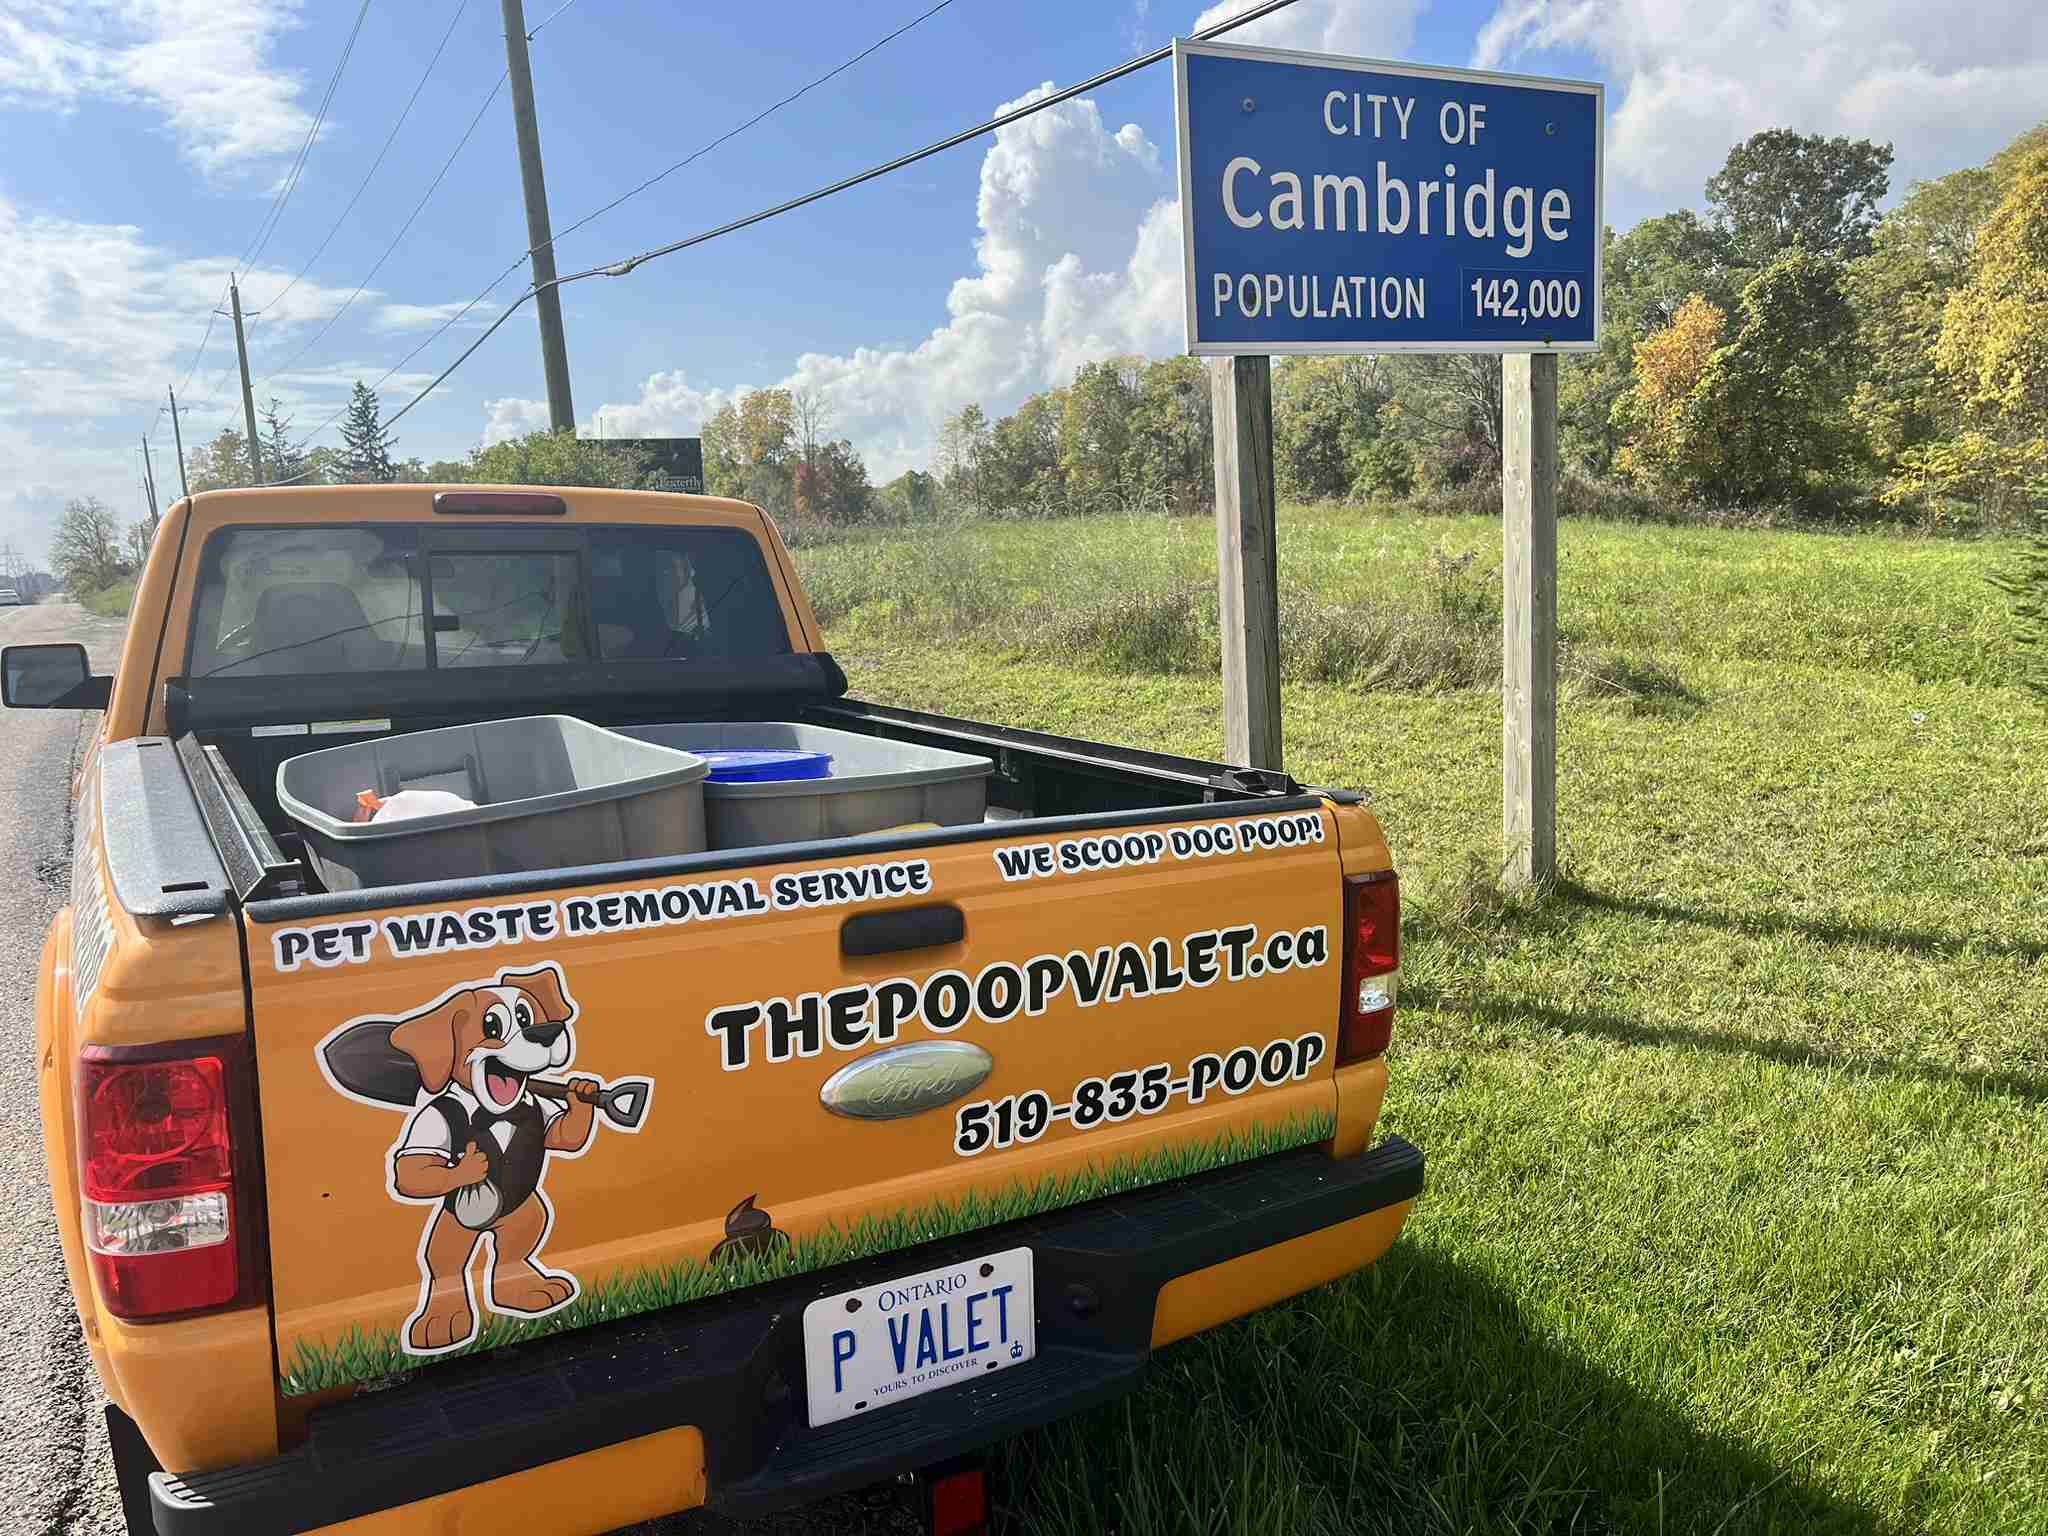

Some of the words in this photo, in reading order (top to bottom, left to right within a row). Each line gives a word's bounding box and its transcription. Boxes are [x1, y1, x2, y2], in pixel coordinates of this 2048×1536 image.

[1323, 90, 1416, 140] CITY
[1439, 101, 1487, 145] OF
[1221, 156, 1572, 258] Cambridge
[1214, 272, 1425, 319] POPULATION
[1471, 277, 1581, 325] 142,000
[998, 847, 1053, 877] WE
[1062, 834, 1163, 869] SCOOP
[1172, 826, 1233, 856] DOG
[1240, 815, 1324, 849] POOP!
[279, 925, 371, 965] PET
[387, 904, 553, 951] WASTE
[566, 883, 766, 934] REMOVAL
[775, 863, 928, 905] SERVICE
[710, 926, 1327, 1067] THEPOOPVALET.ca
[868, 1063, 959, 1105] Ford
[957, 1036, 1324, 1152] 519-835-POOP
[878, 1273, 967, 1312] ONTARIO
[832, 1329, 856, 1393] P
[888, 1284, 1013, 1374] VALET
[873, 1379, 908, 1396] YOURS
[911, 1373, 926, 1385] TO
[928, 1358, 978, 1379] DISCOVER
